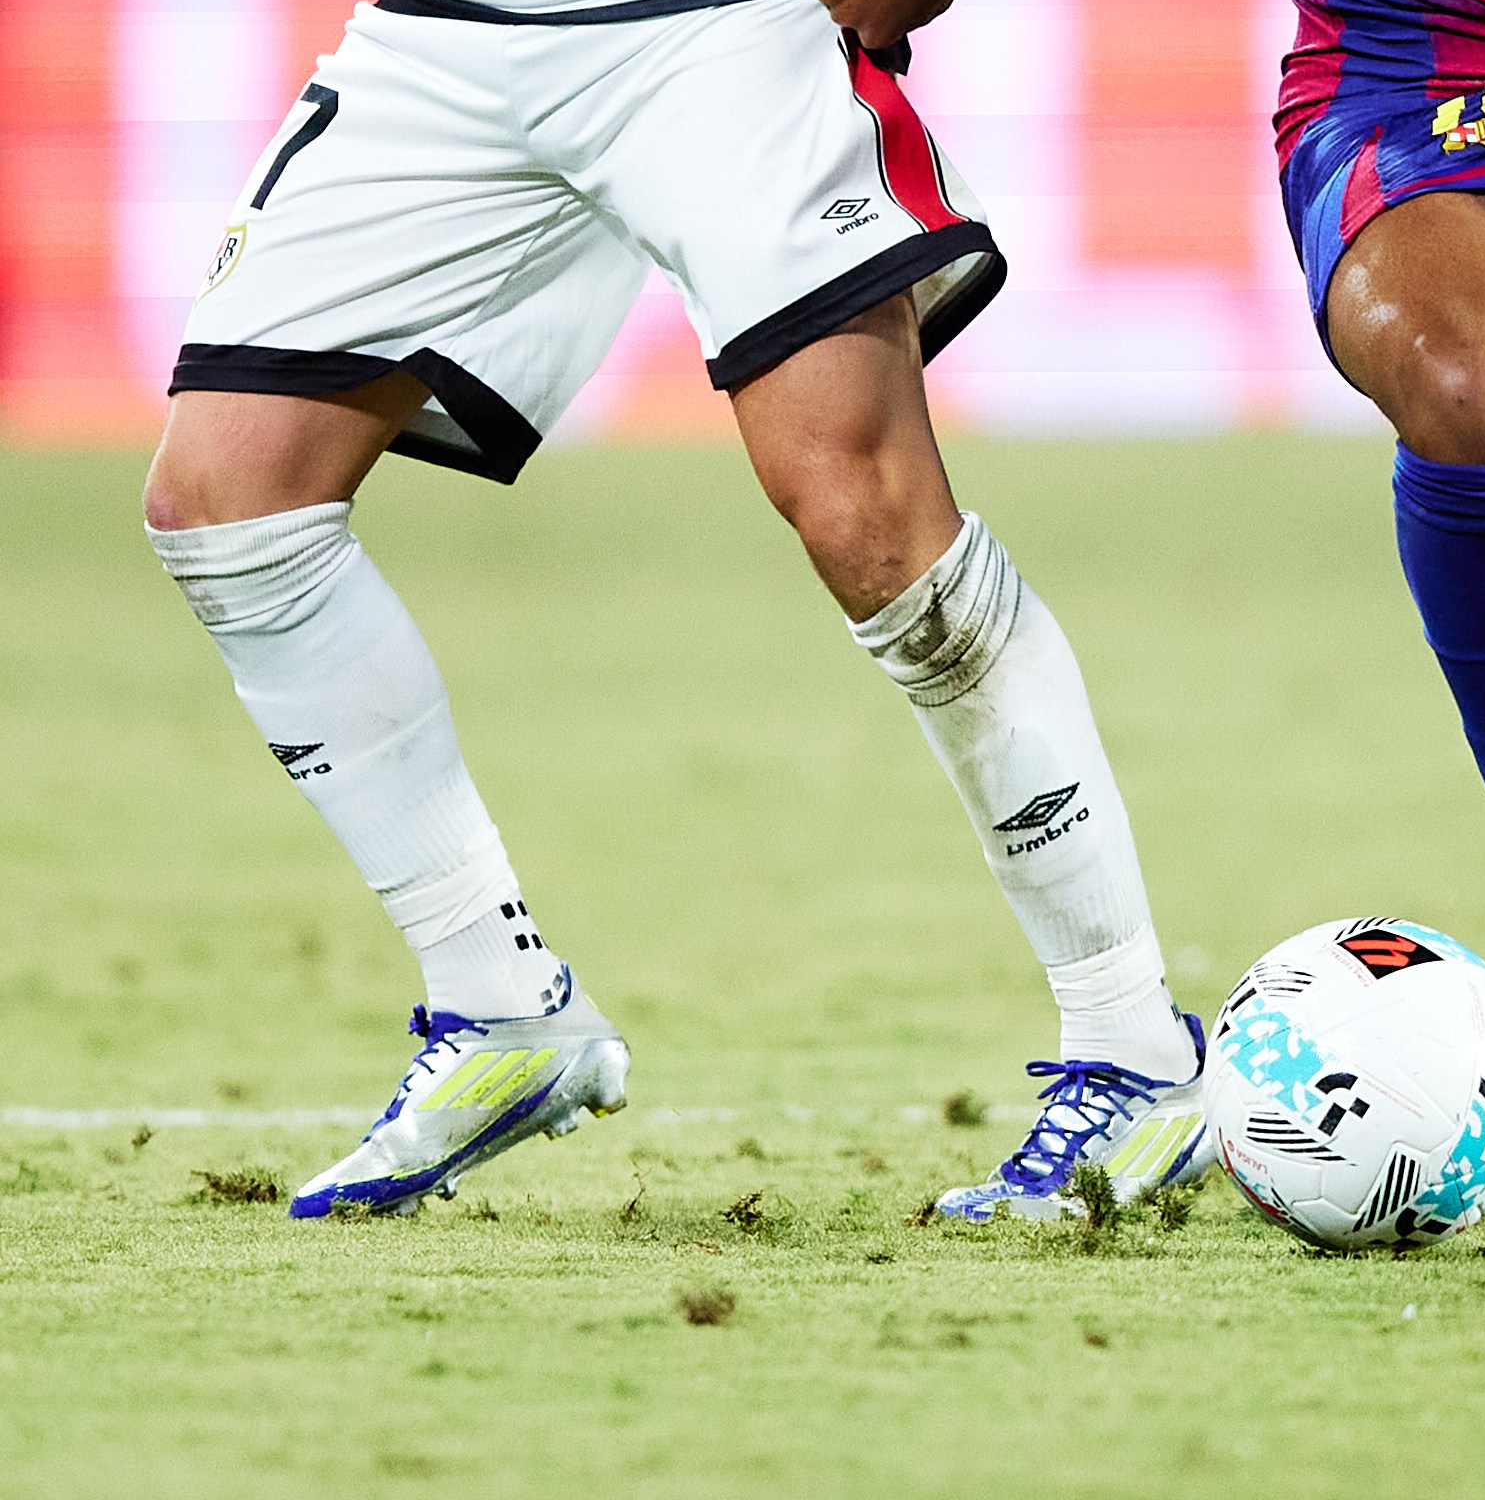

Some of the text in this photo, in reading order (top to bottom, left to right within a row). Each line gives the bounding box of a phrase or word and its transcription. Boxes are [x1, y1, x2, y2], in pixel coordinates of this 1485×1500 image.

[250, 82, 339, 212] 7
[836, 212, 879, 235] umbro
[1006, 806, 1090, 857] umbro
